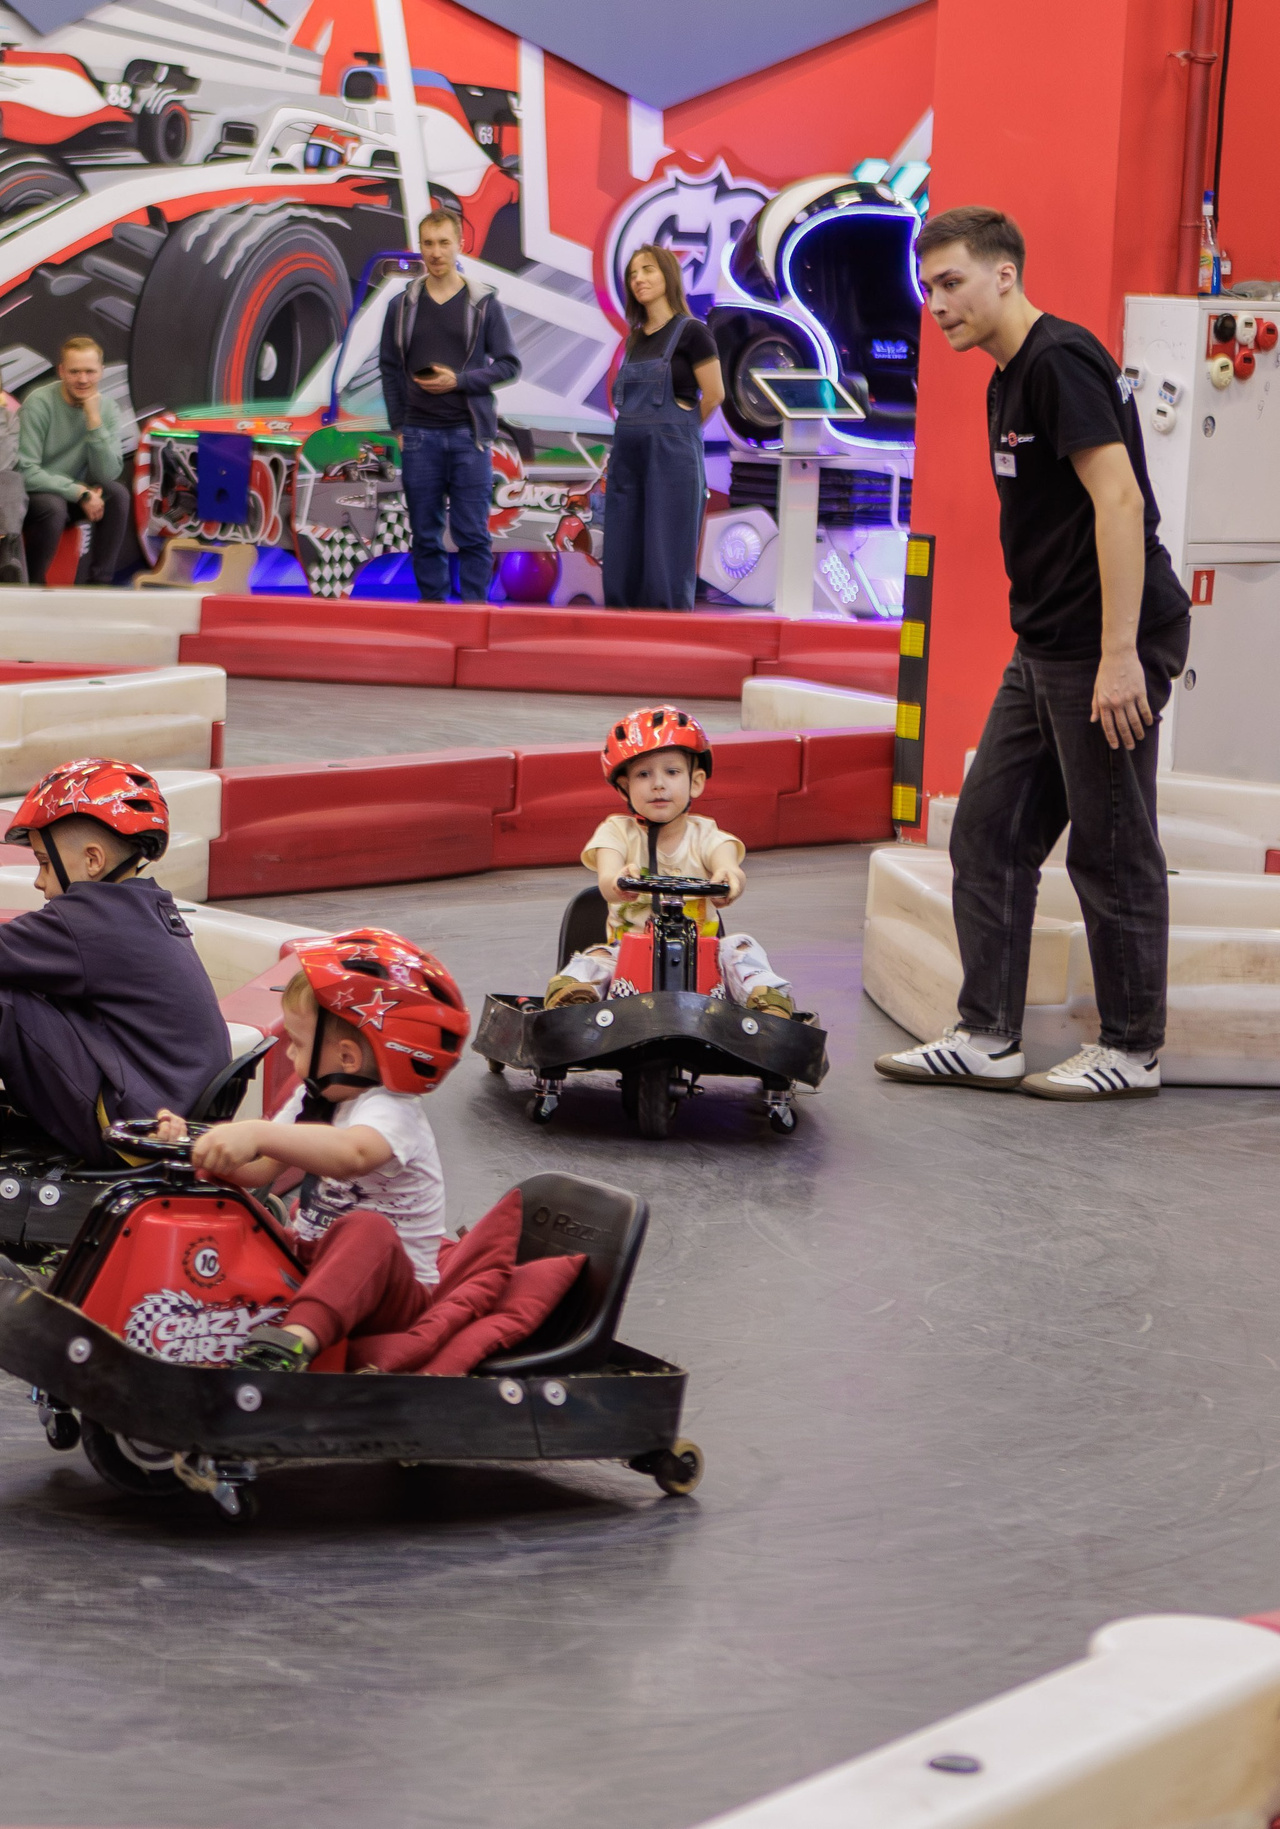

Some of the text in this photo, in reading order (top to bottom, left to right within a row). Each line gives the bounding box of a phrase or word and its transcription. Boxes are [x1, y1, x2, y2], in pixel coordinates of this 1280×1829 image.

[107, 83, 132, 109] 88
[478, 126, 494, 145] 63
[200, 1253, 218, 1273] 10
[156, 1307, 290, 1342] CRAZY
[160, 1335, 246, 1363] CART
